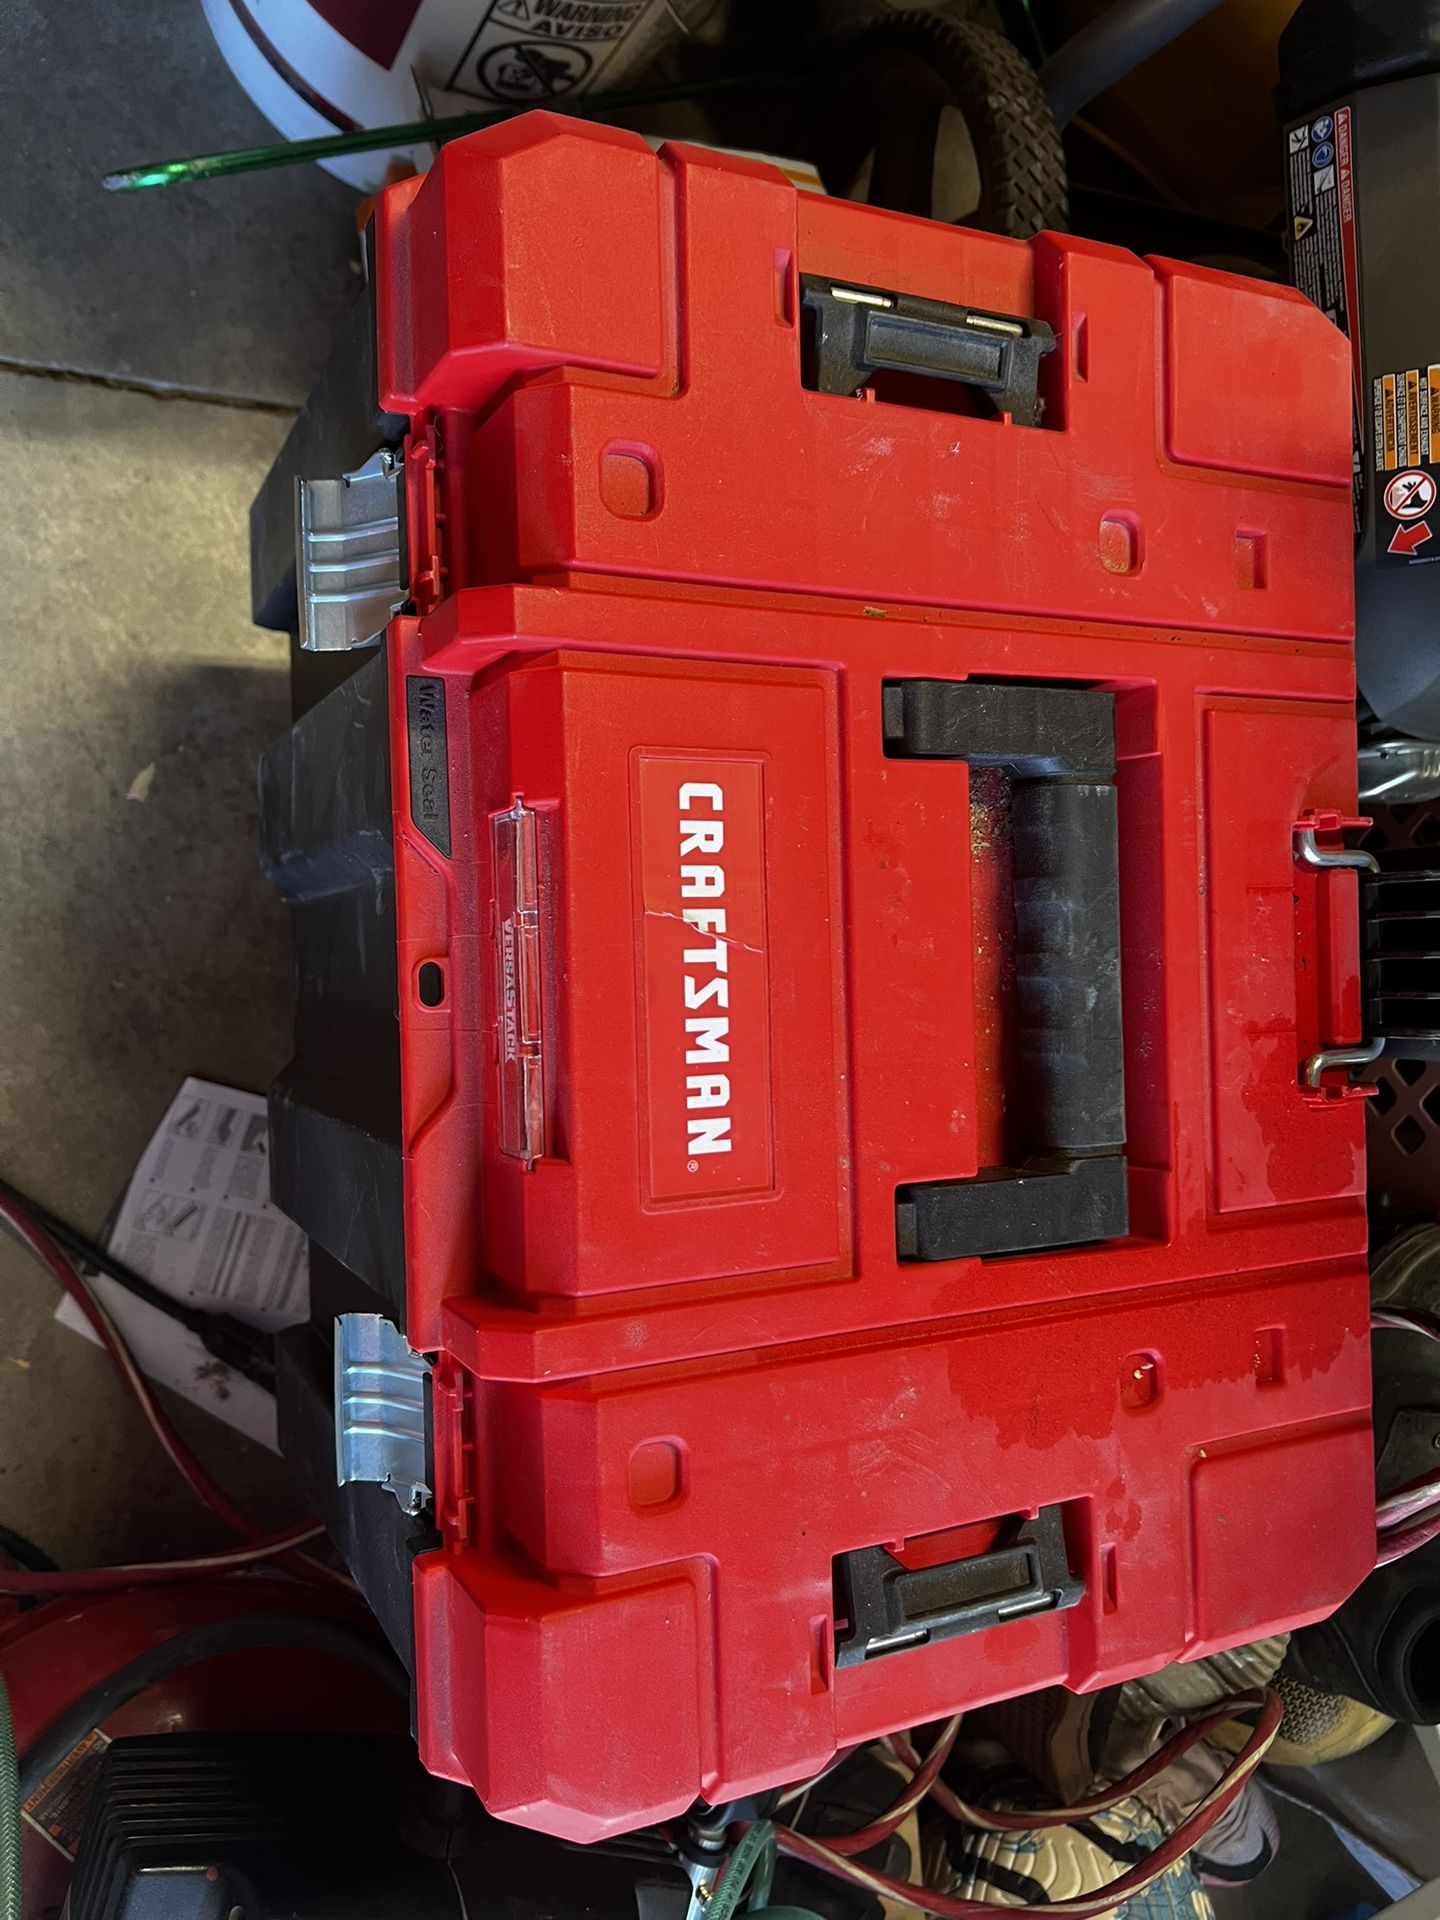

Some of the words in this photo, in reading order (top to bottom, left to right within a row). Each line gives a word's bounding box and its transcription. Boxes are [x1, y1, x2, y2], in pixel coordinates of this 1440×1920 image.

[531, 20, 623, 38] AVISO
[533, 0, 641, 22] WARNING
[1339, 123, 1349, 167] DANGER
[1341, 179, 1352, 224] DANGER
[1407, 391, 1419, 454] AVERTISSEMENT
[1430, 395, 1440, 434] WARNING
[419, 684, 436, 759] Water
[421, 766, 438, 820] Seal
